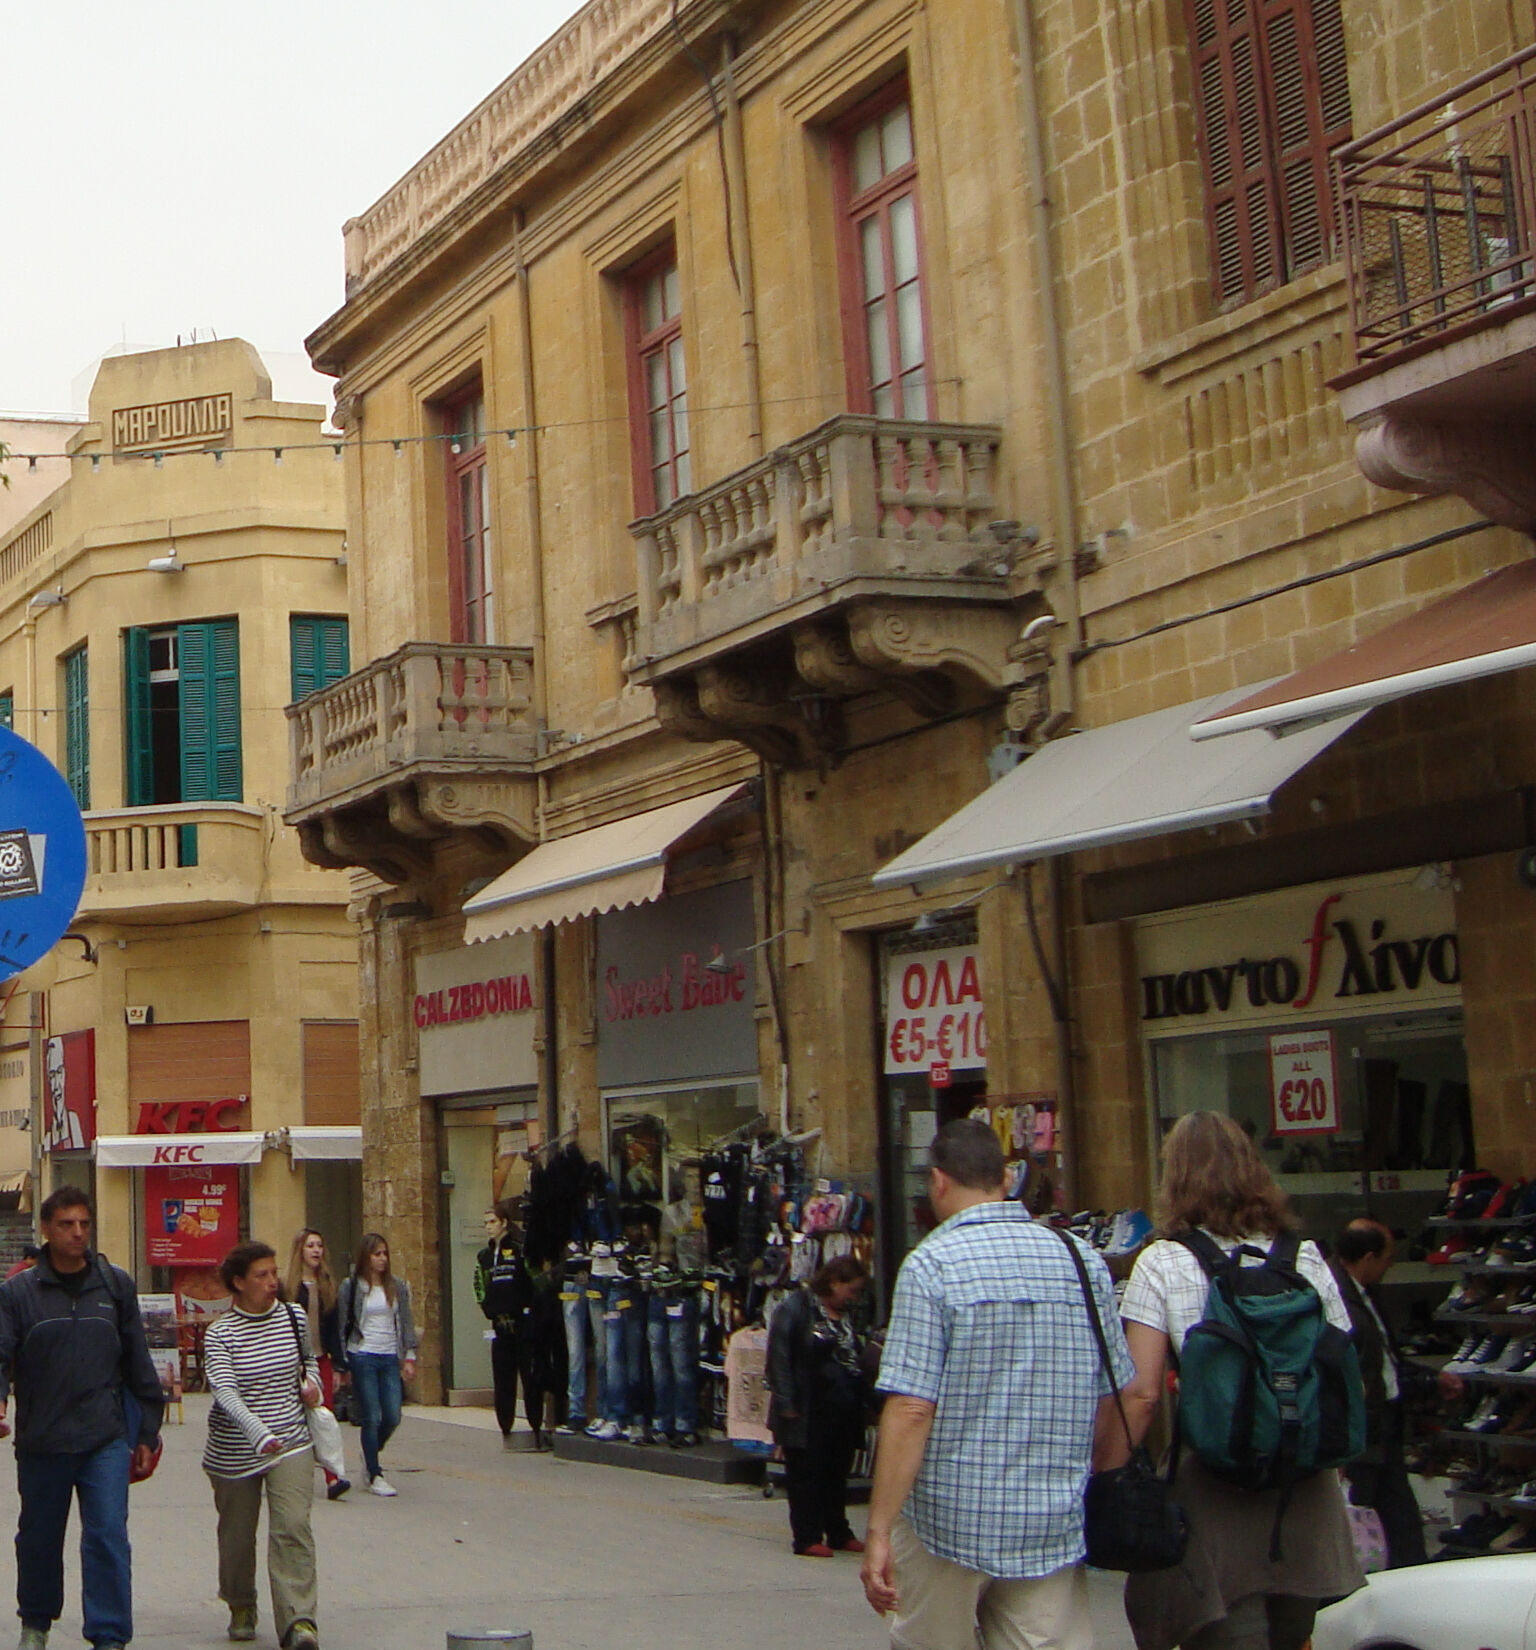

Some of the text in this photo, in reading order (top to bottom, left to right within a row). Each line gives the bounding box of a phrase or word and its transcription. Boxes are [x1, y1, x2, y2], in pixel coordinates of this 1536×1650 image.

[603, 965, 674, 1022] Sweet
[1292, 1060, 1312, 1072] ALL
[135, 1098, 241, 1134] KFC
[1279, 1077, 1326, 1122] €20
[152, 1145, 204, 1163] KFC
